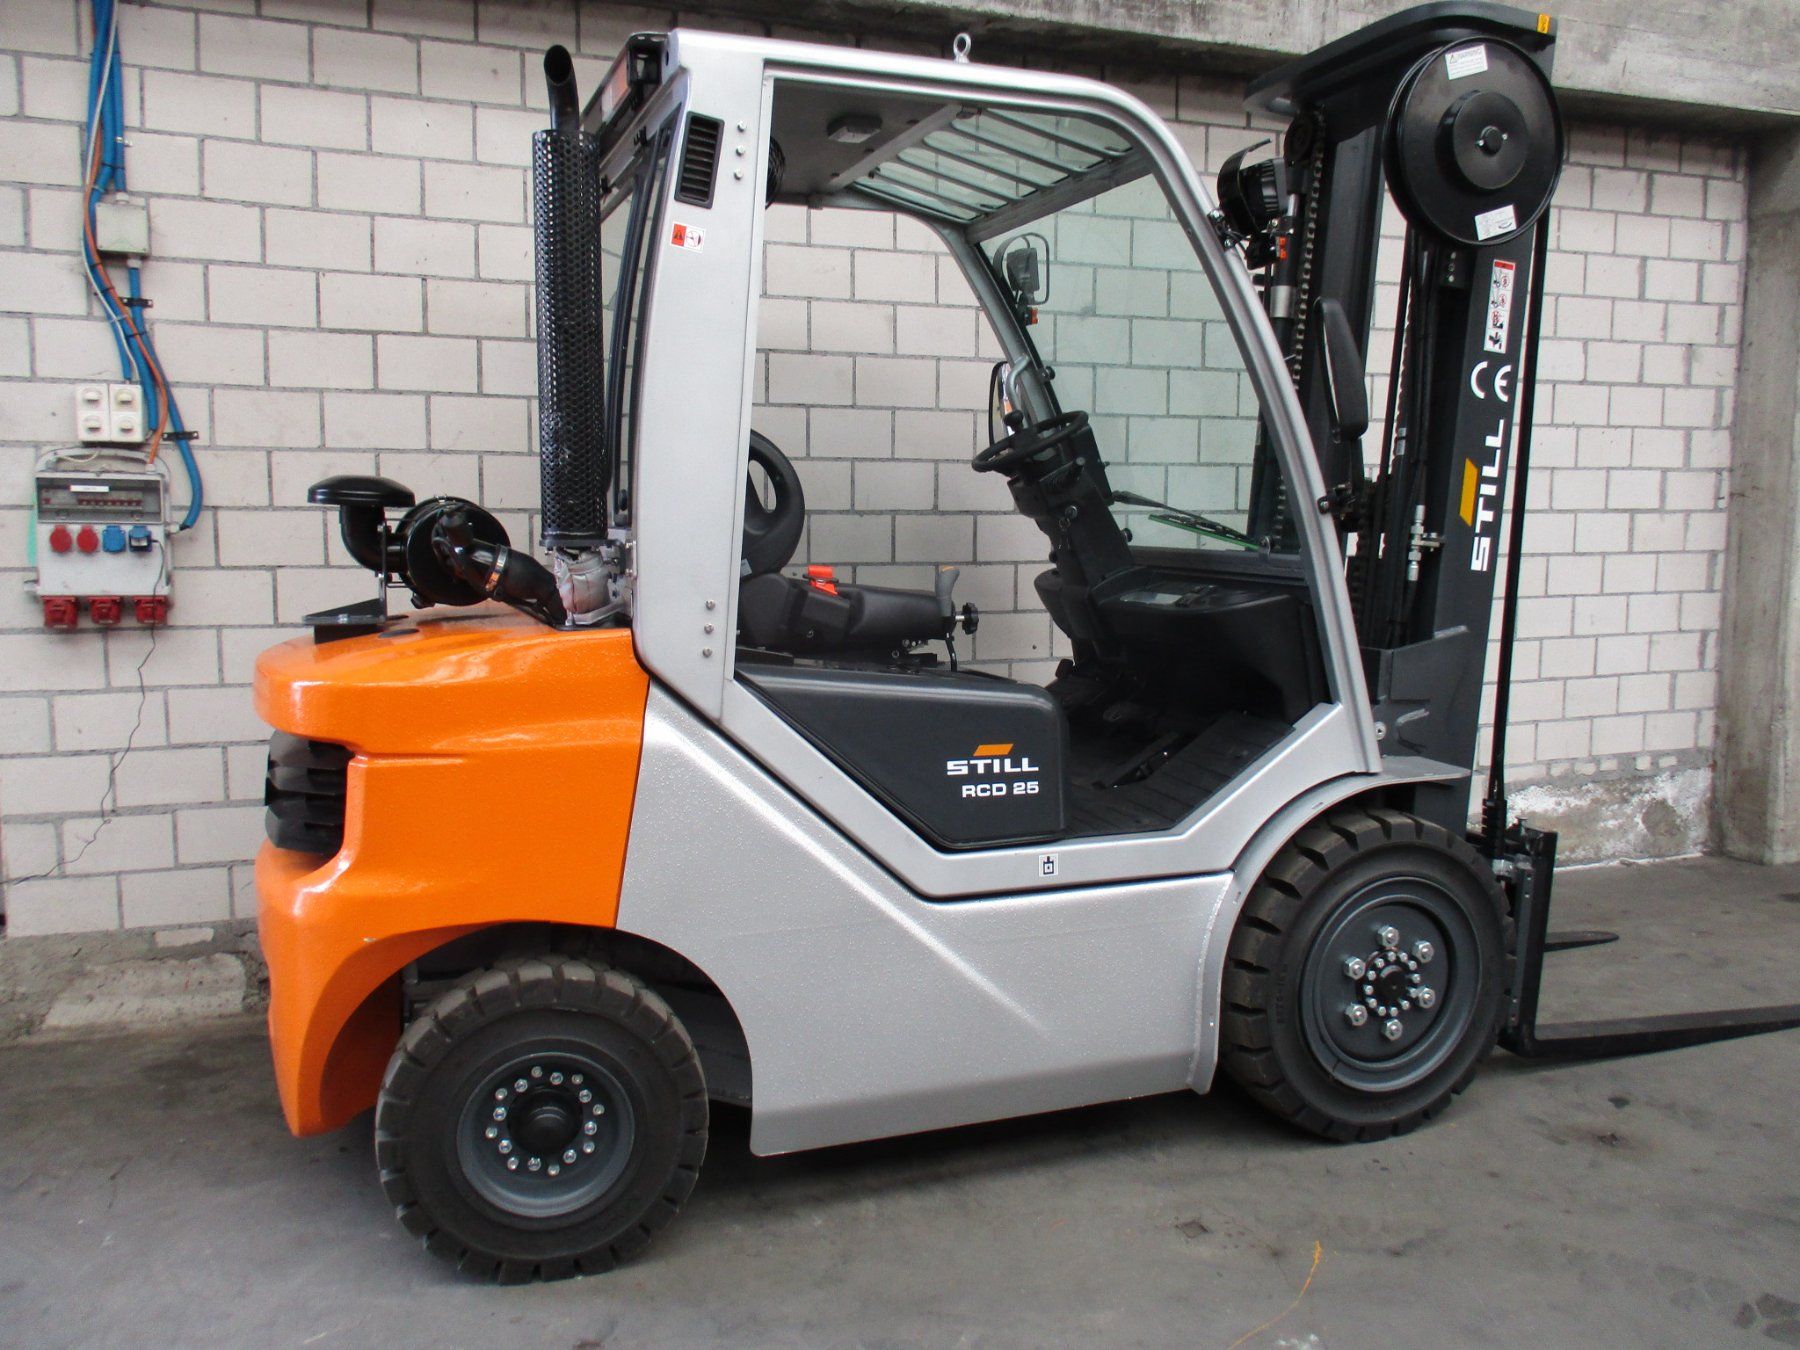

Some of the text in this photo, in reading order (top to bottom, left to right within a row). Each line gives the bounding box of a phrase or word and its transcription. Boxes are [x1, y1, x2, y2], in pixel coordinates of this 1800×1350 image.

[1470, 361, 1512, 403] CE
[1470, 419, 1505, 572] STILL
[946, 757, 1040, 776] STILL
[961, 781, 1040, 798] RCD 25
